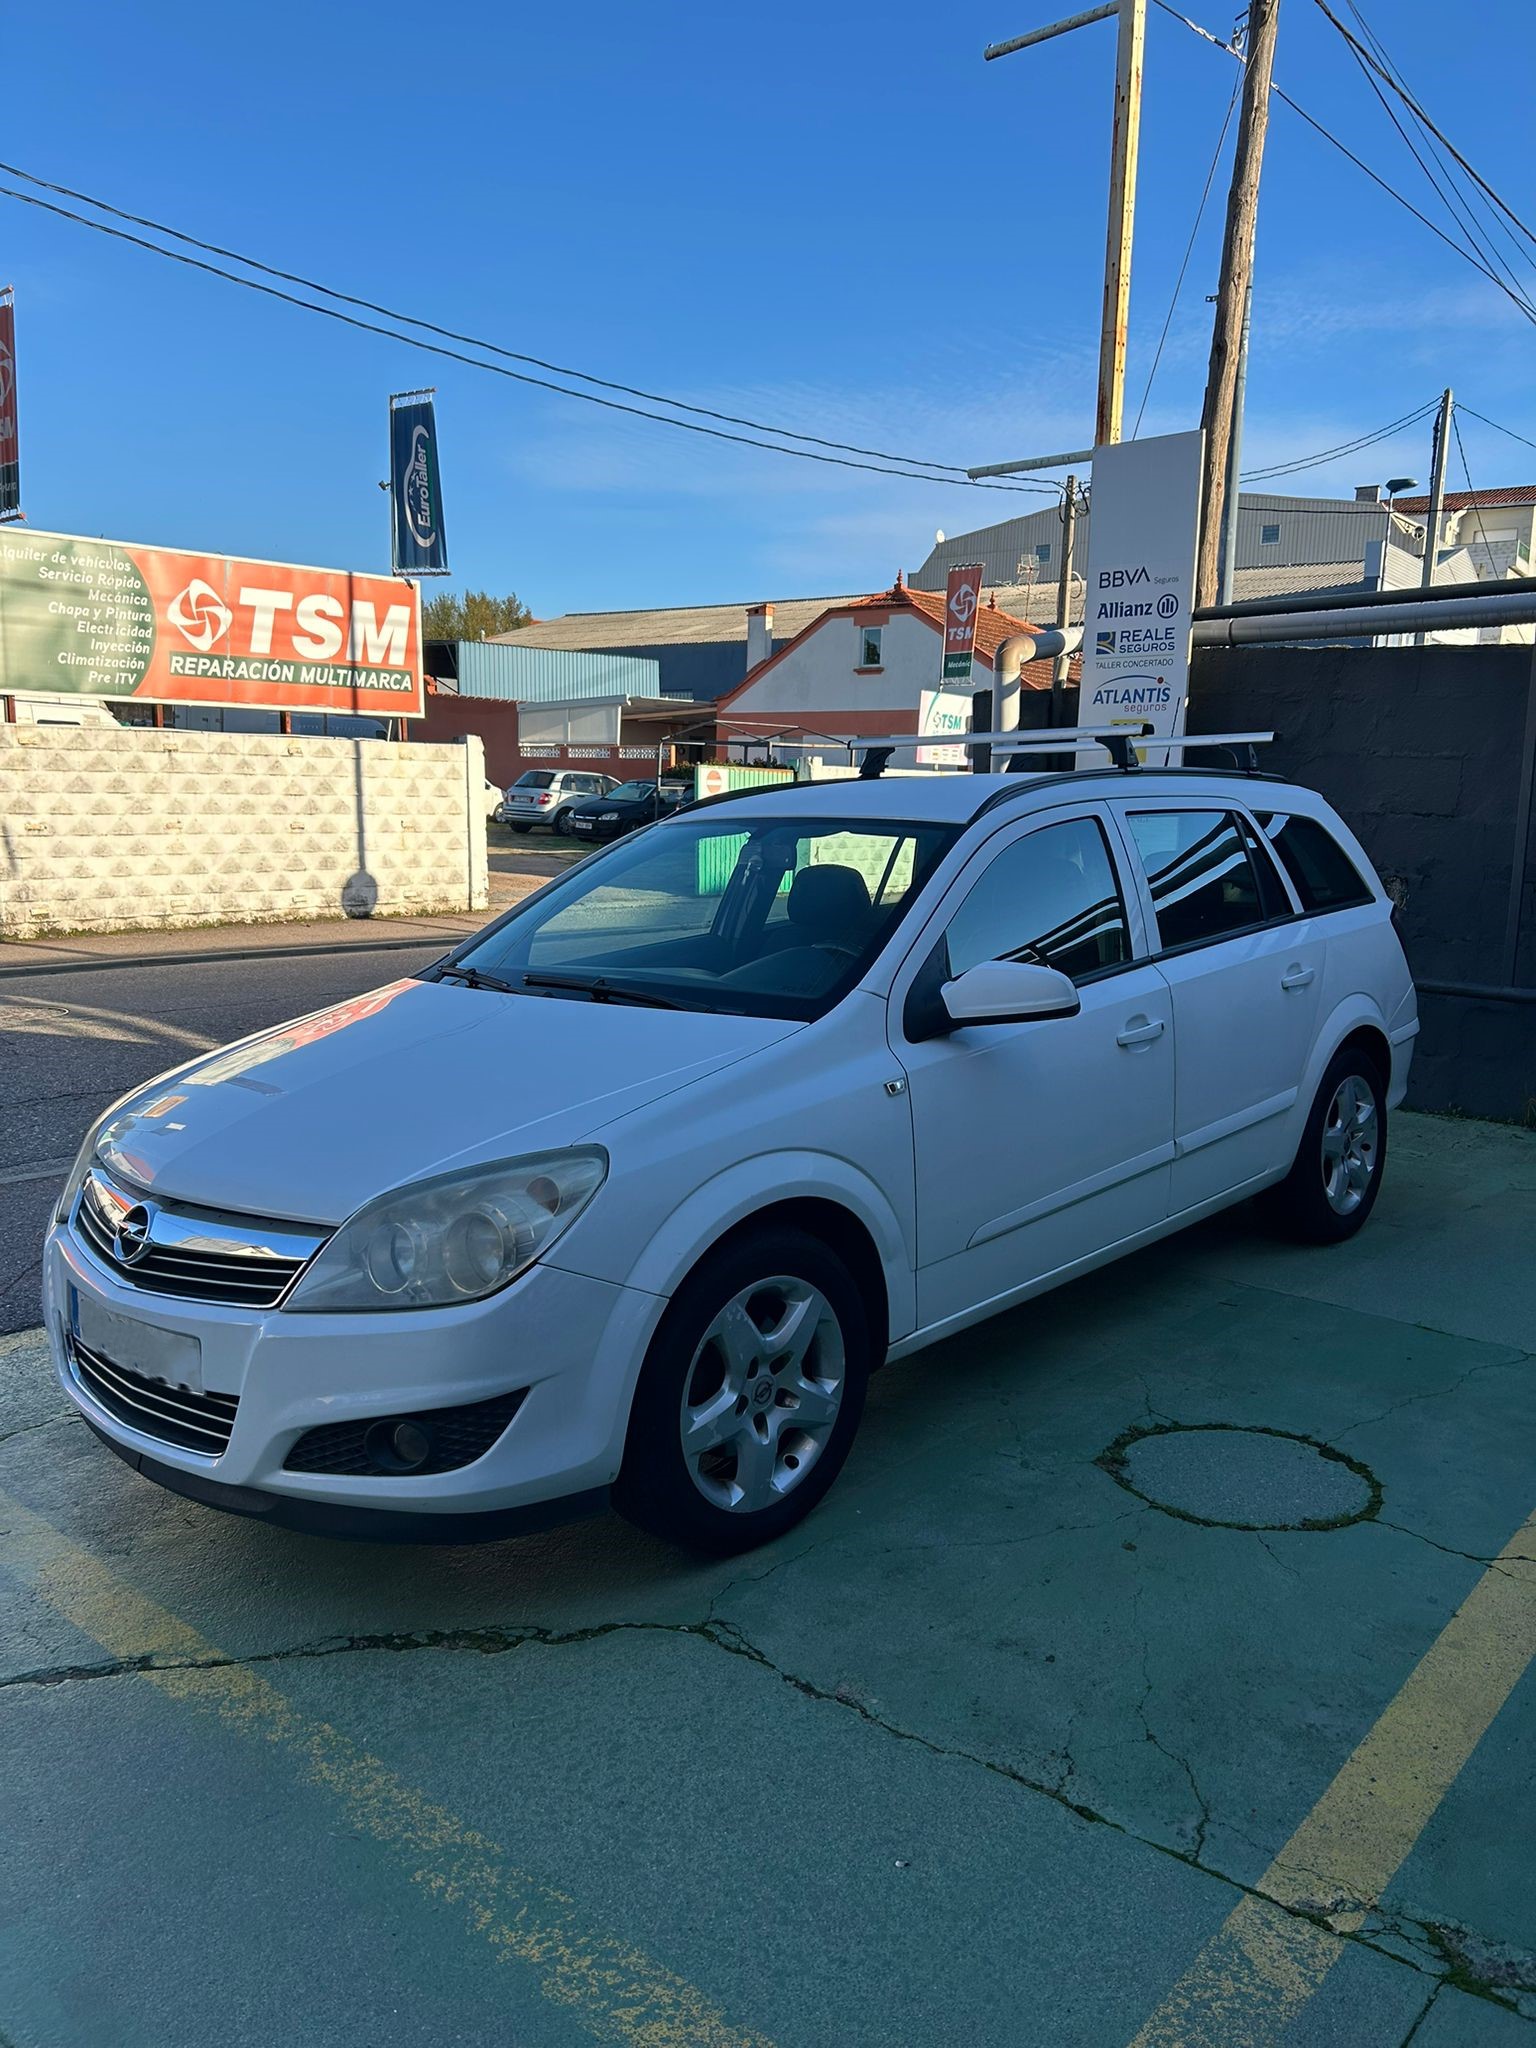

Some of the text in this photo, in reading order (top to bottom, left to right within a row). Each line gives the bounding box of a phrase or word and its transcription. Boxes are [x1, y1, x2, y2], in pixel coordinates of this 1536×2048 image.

[415, 443, 431, 528] EuroTaller
[51, 551, 67, 564] de
[70, 554, 132, 572] vehículos
[38, 566, 93, 584] Servicio
[1099, 566, 1179, 589] BBVA Seguros
[88, 589, 148, 606] Mecánica
[48, 601, 152, 623] Chapa y Pintura
[1097, 602, 1152, 620] Allianz
[77, 621, 153, 639] Electricidad
[239, 586, 411, 666] TSM
[1119, 627, 1175, 643] REALE
[90, 638, 150, 655] Inyección
[1119, 641, 1175, 654] SEGUROS
[58, 652, 145, 670] Climatización
[1096, 658, 1173, 670] TALLER CONCERTADO
[88, 670, 137, 686] Pre ITV
[170, 655, 412, 691] REPARACIÓN MULTIMARCA
[1093, 687, 1170, 705] ATLANTIS
[1124, 703, 1167, 715] seguros
[942, 713, 962, 730] TSM
